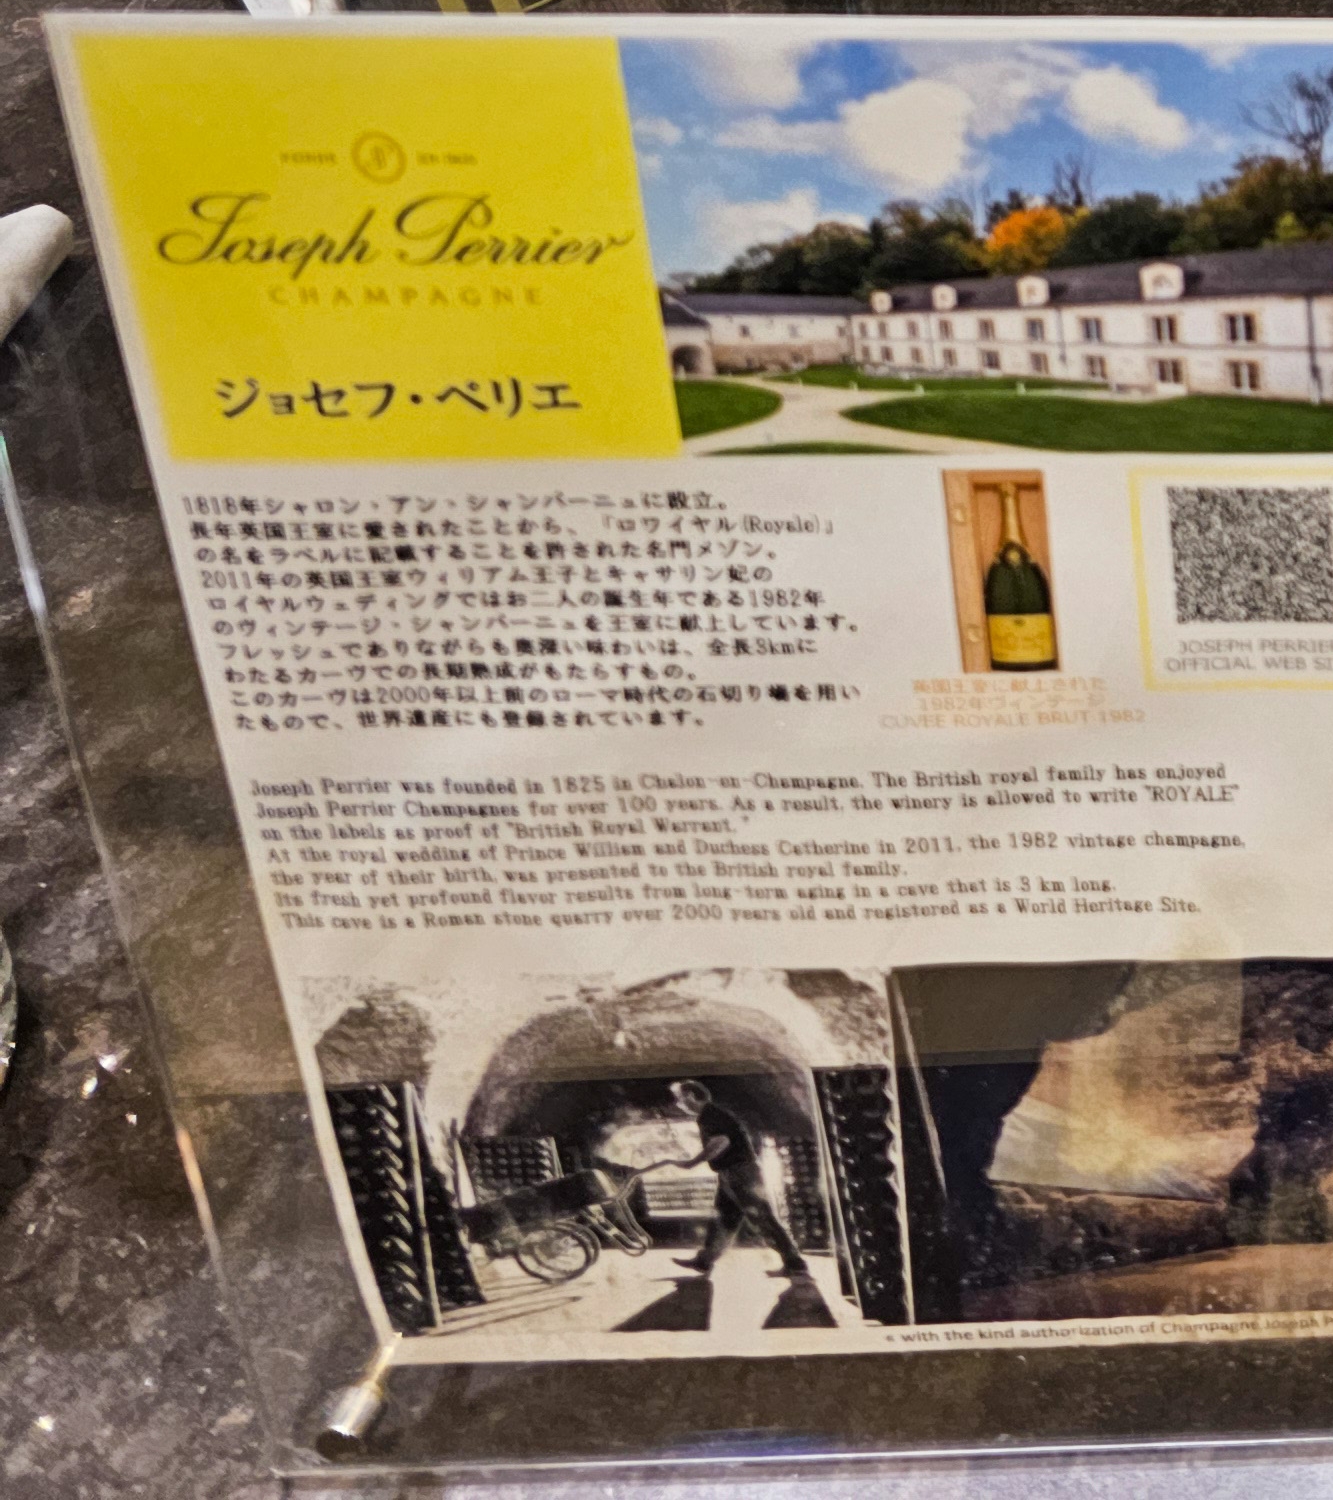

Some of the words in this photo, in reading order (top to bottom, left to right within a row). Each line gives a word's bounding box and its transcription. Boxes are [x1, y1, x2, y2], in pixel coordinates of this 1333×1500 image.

[158, 191, 377, 280] Joseph
[394, 191, 636, 266] Perrier
[267, 284, 543, 308] CHAMPAGNE
[1178, 638, 1253, 654] JOSEPH
[1165, 656, 1255, 672] OFFICIAL
[1264, 656, 1307, 671] WEB
[251, 779, 314, 798] Joseph
[321, 777, 391, 795] Perrier
[401, 780, 435, 794] was
[443, 777, 517, 795] founded
[525, 778, 544, 795] in
[553, 776, 605, 794] 1825
[613, 776, 632, 791] in
[872, 771, 908, 788] The
[915, 768, 982, 787] British
[990, 767, 1038, 784] royal
[1048, 765, 1106, 782] family
[1116, 764, 1147, 780] has
[1156, 763, 1226, 782] enjoyed
[256, 802, 319, 820] Joseph
[326, 800, 396, 817] Perrier
[403, 799, 520, 819] Champagnes
[529, 800, 558, 816] for
[567, 802, 609, 815] over
[617, 796, 657, 813] 100
[732, 795, 756, 812] As
[852, 794, 883, 811] the
[891, 793, 951, 810] winery
[961, 793, 978, 807] is
[987, 789, 1055, 806] allowed
[1064, 789, 1082, 803] to
[1091, 788, 1137, 803] write
[261, 827, 283, 841] on
[290, 824, 323, 840] the
[330, 823, 386, 840] labels
[395, 827, 416, 840] as
[423, 822, 473, 842] proof
[482, 822, 499, 839] of
[590, 818, 646, 837] Royal
[267, 848, 290, 864] At
[300, 847, 331, 863] the
[340, 847, 386, 865] royal
[396, 846, 471, 864] wedding
[479, 845, 498, 861] of
[504, 843, 567, 861] Prince
[574, 840, 646, 858] William
[655, 839, 687, 856] and
[695, 838, 770, 856] Duchess
[777, 838, 870, 856] Catherine
[878, 838, 896, 854] in
[969, 834, 1000, 850] the
[1008, 831, 1058, 849] 1982
[1066, 831, 1136, 849] vintage
[270, 869, 304, 885] the
[311, 871, 352, 887] year
[360, 869, 379, 885] of
[387, 868, 435, 885] their
[504, 869, 538, 883] was
[546, 862, 641, 884] presented
[650, 862, 668, 877] to
[675, 861, 706, 877] the
[712, 860, 779, 878] British
[787, 862, 835, 879] royal
[282, 912, 324, 929] This
[331, 916, 372, 930] cave
[380, 914, 397, 929] is
[423, 912, 485, 928] Roman
[494, 910, 542, 926] stone
[551, 909, 613, 928] quarry
[622, 908, 663, 923] over
[672, 903, 723, 920] 2000
[730, 905, 781, 922] years
[790, 904, 815, 921] old
[824, 904, 856, 920] and
[864, 900, 960, 920] registered
[969, 902, 988, 915] as
[1015, 897, 1067, 915] World
[1074, 897, 1153, 915] Heritage
[901, 1329, 940, 1342] with
[944, 1328, 973, 1341] the
[979, 1328, 1014, 1340] kind
[1140, 1322, 1155, 1334] of
[1161, 1320, 1260, 1335] Champagne
